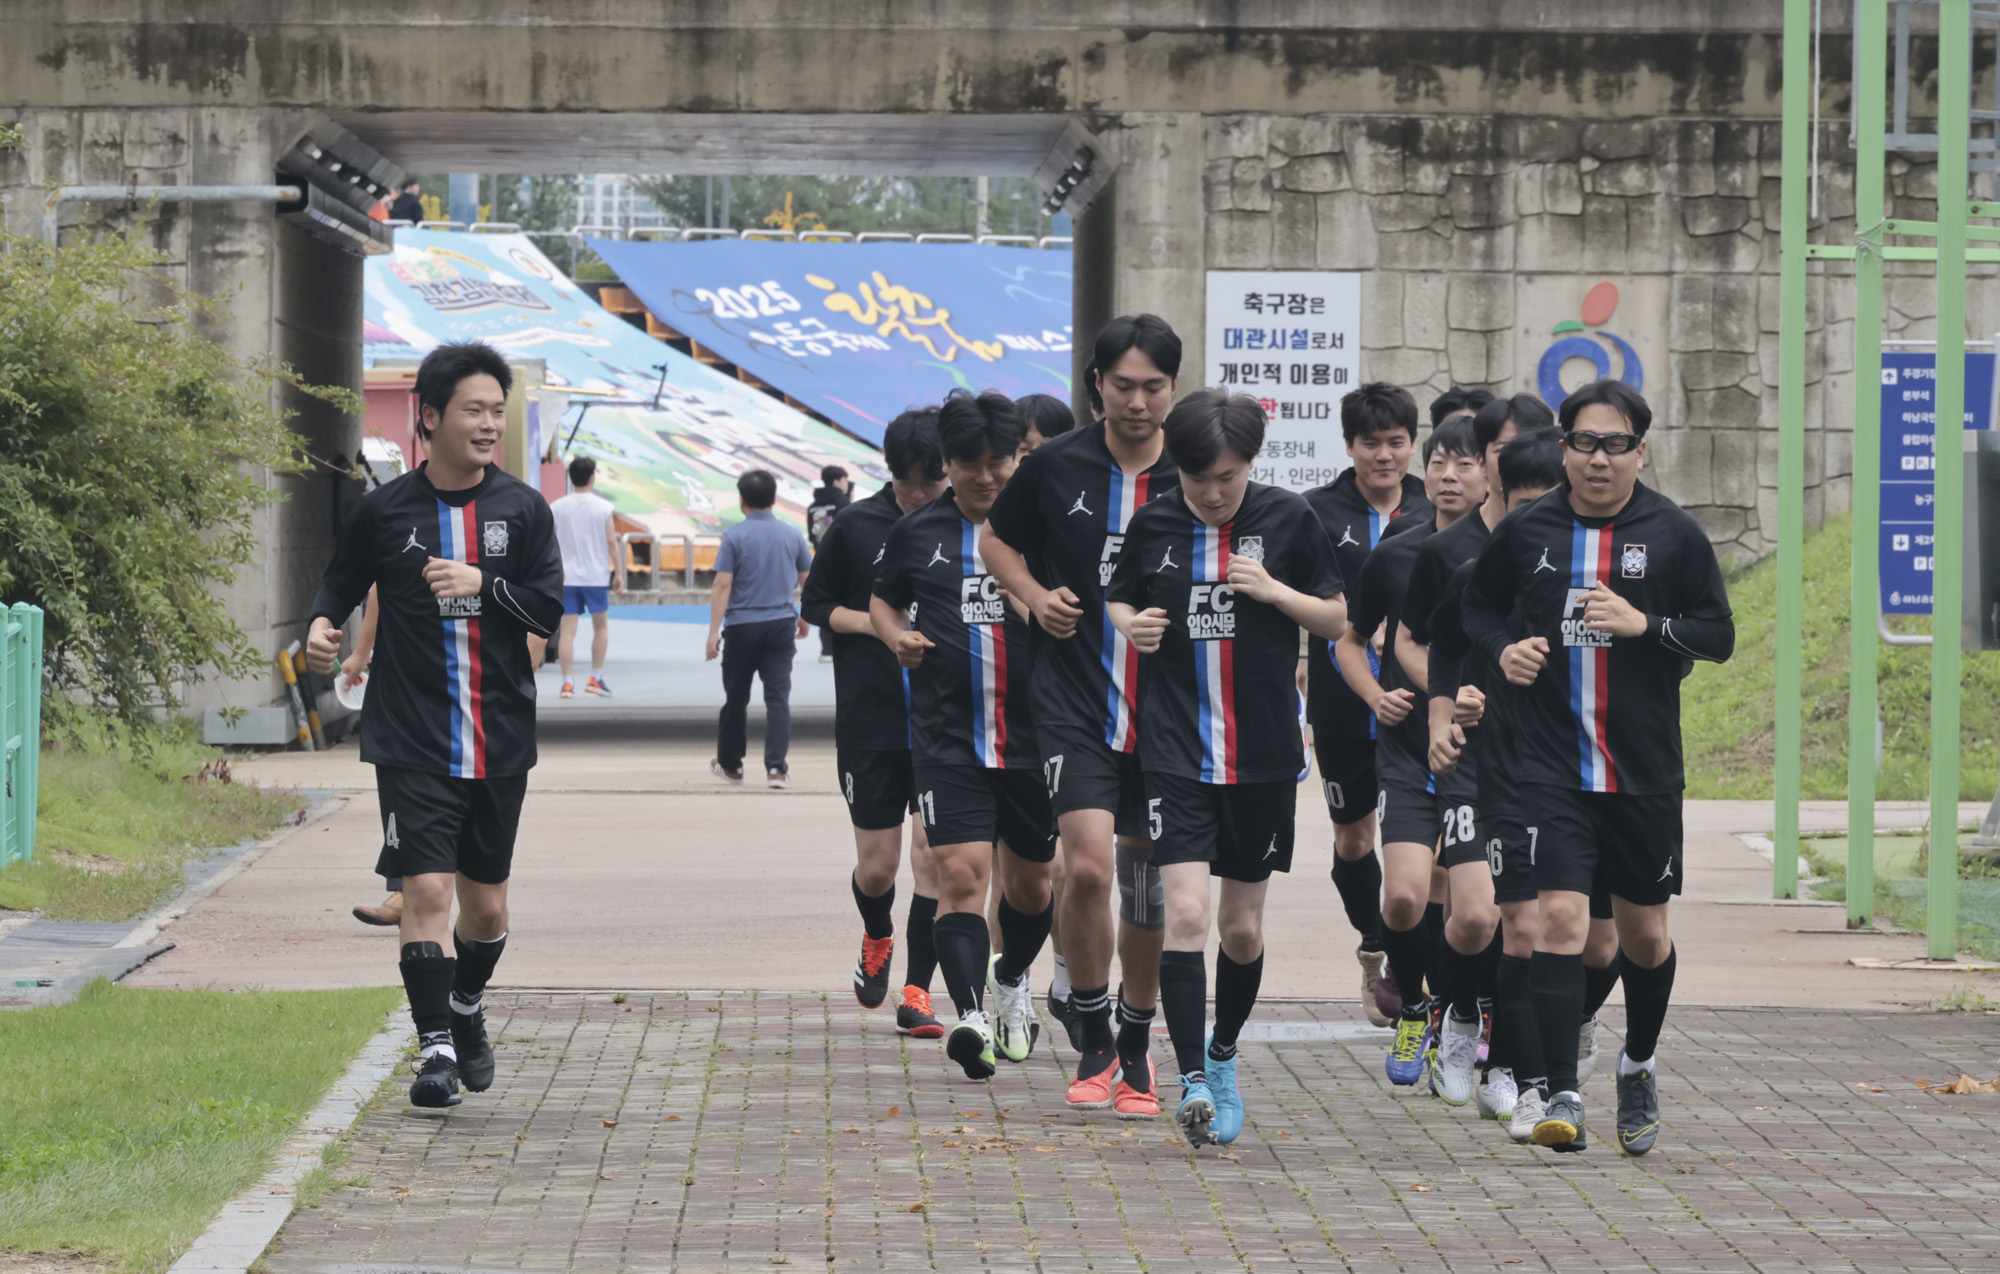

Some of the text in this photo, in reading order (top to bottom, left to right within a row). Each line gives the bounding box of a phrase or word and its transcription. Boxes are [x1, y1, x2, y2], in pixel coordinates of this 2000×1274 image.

[388, 257, 460, 284] 2025
[694, 280, 801, 319] 2025
[1243, 292, 1325, 315] 축구장은
[749, 317, 892, 357] 안동국제
[1223, 327, 1344, 350] 대관시설로서
[1218, 363, 1348, 385] 개인적 이용이
[1258, 397, 1331, 420] 한됩니다
[1902, 390, 1930, 401] 본부석
[1100, 534, 1125, 561] F
[961, 576, 1001, 603] FC
[1187, 584, 1236, 614] FC
[960, 601, 1006, 624] 일요신문
[1186, 612, 1236, 640] 일요신문
[917, 790, 936, 828] 11
[1148, 797, 1163, 841] 5
[386, 811, 401, 850] 4
[1442, 804, 1476, 848] 28
[1526, 826, 1539, 866] 7
